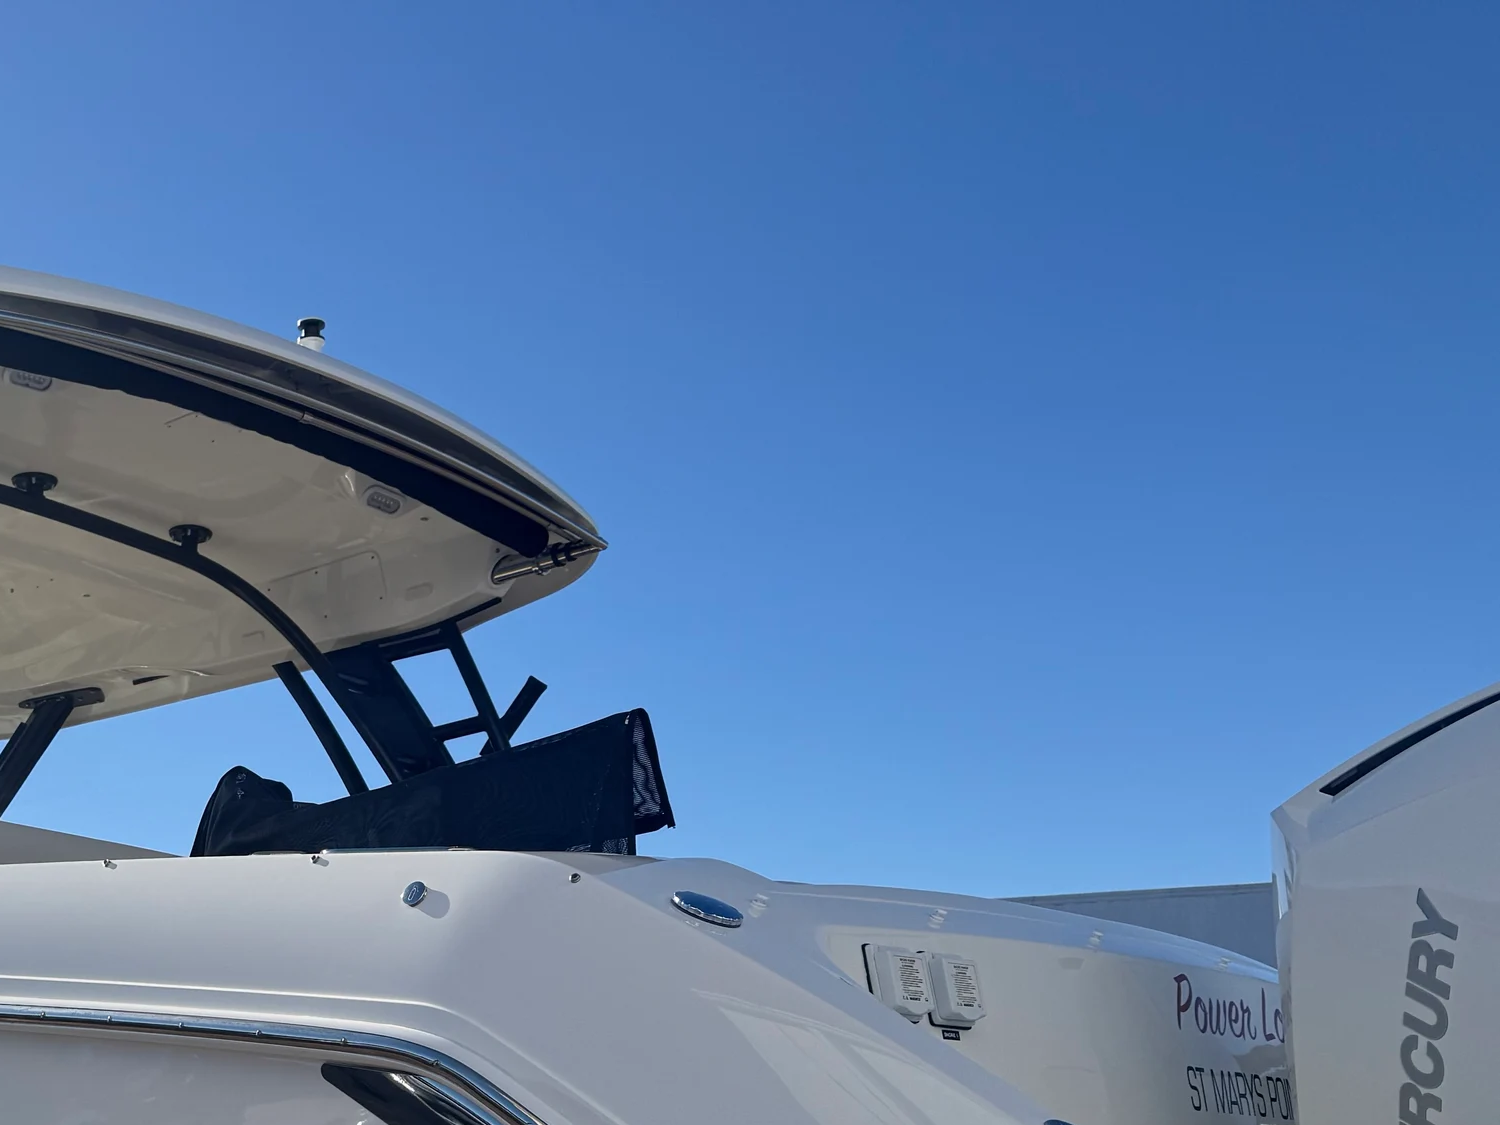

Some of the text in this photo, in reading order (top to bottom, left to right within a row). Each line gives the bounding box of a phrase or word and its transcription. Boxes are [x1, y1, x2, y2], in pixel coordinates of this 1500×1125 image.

[1173, 973, 1257, 1041] Power
[1186, 1065, 1208, 1112] ST
[1210, 1068, 1267, 1118] MARYS
